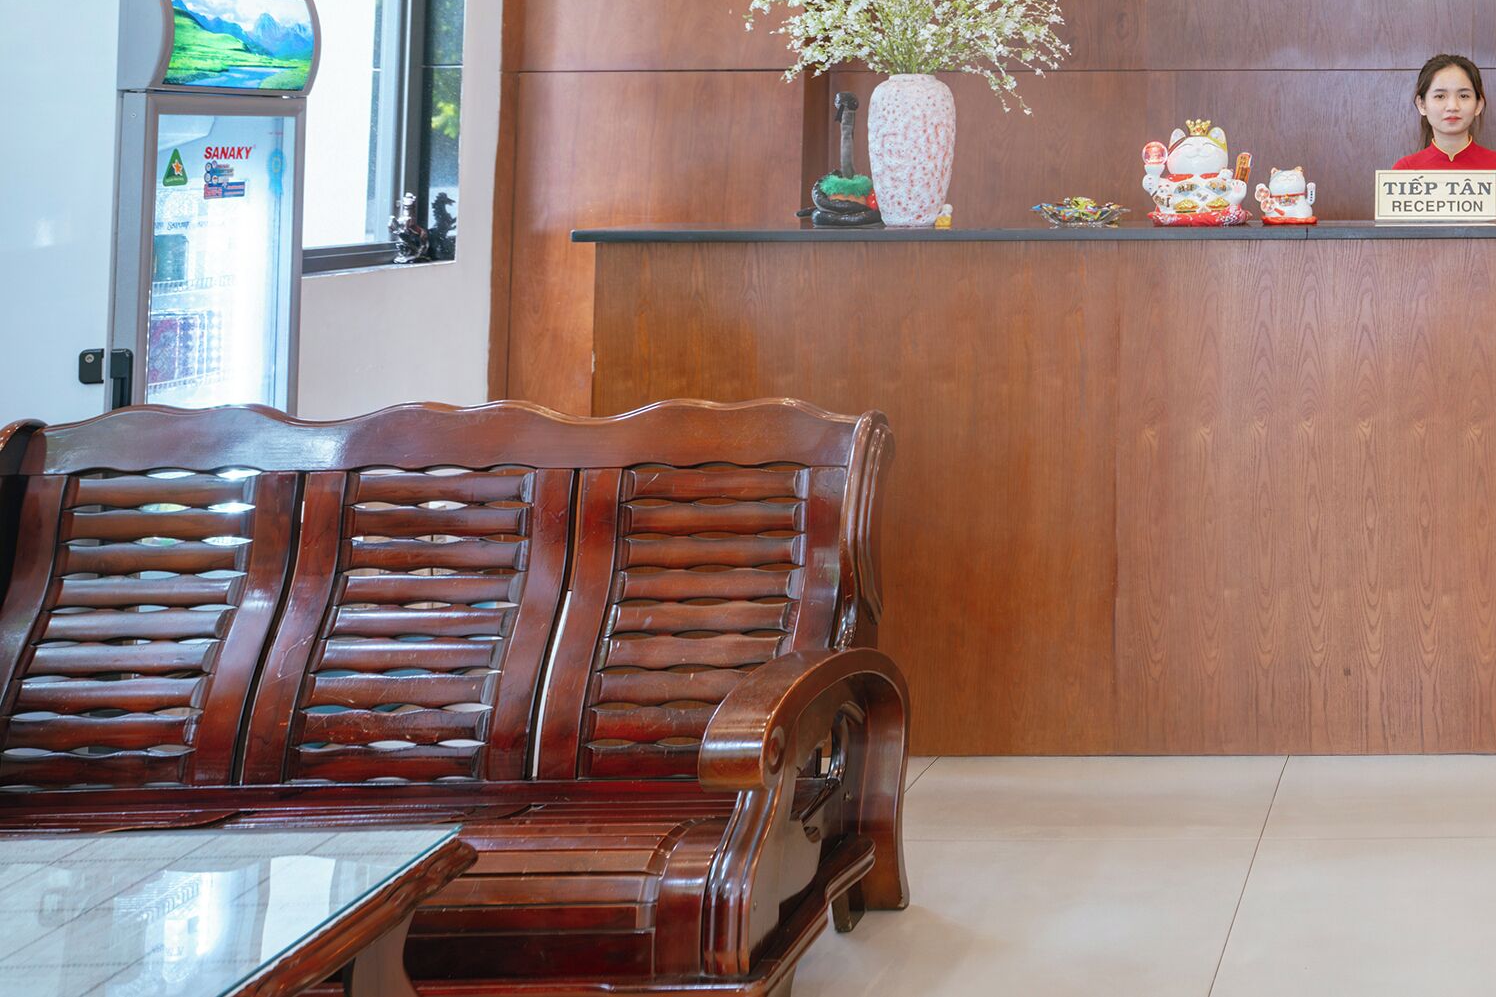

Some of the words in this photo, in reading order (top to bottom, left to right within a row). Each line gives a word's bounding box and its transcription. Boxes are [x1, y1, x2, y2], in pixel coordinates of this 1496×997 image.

[204, 147, 252, 159] SANAKY
[1383, 176, 1438, 195] TIẾP
[1446, 179, 1492, 195] TÂN
[1392, 201, 1483, 212] RECEPTION
